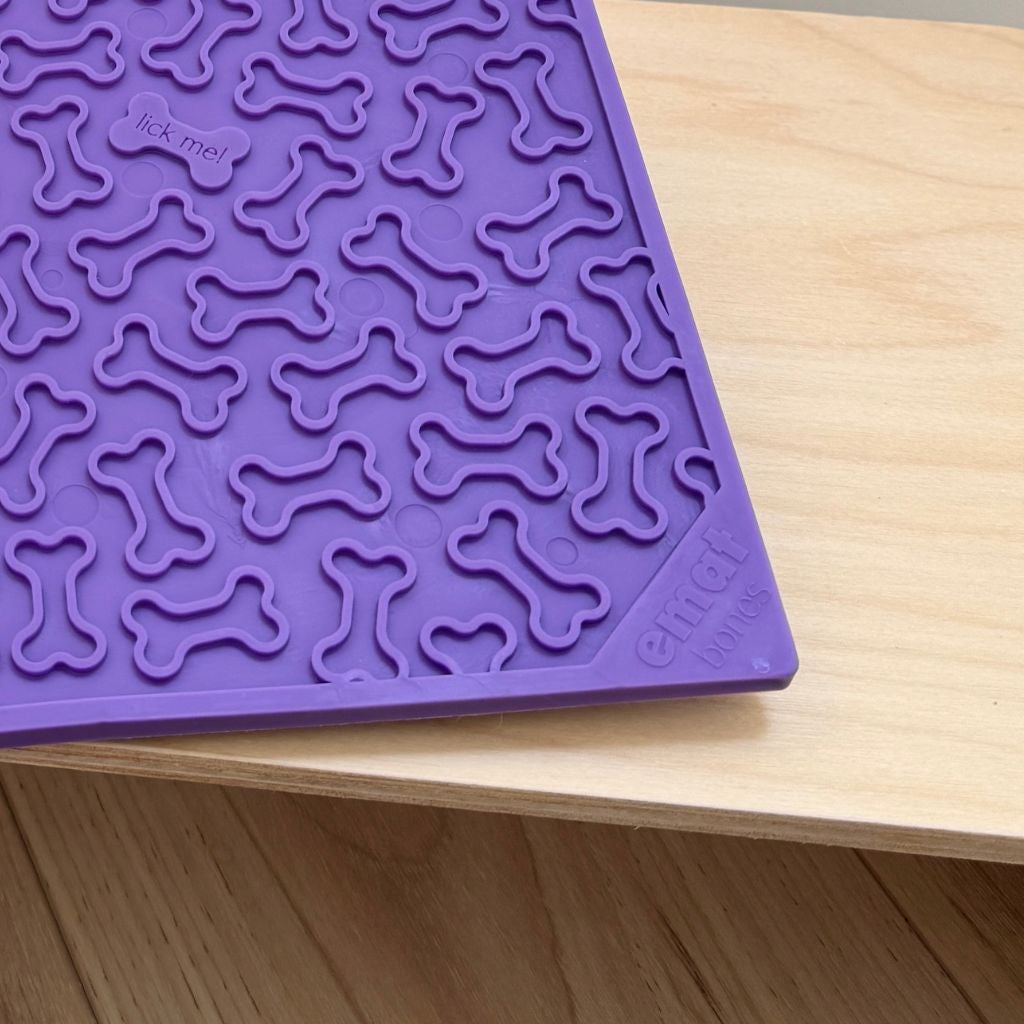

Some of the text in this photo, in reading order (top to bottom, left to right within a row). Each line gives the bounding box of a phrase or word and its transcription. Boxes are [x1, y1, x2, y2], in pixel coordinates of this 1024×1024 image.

[135, 112, 228, 164] lick me!
[635, 527, 750, 668] emat
